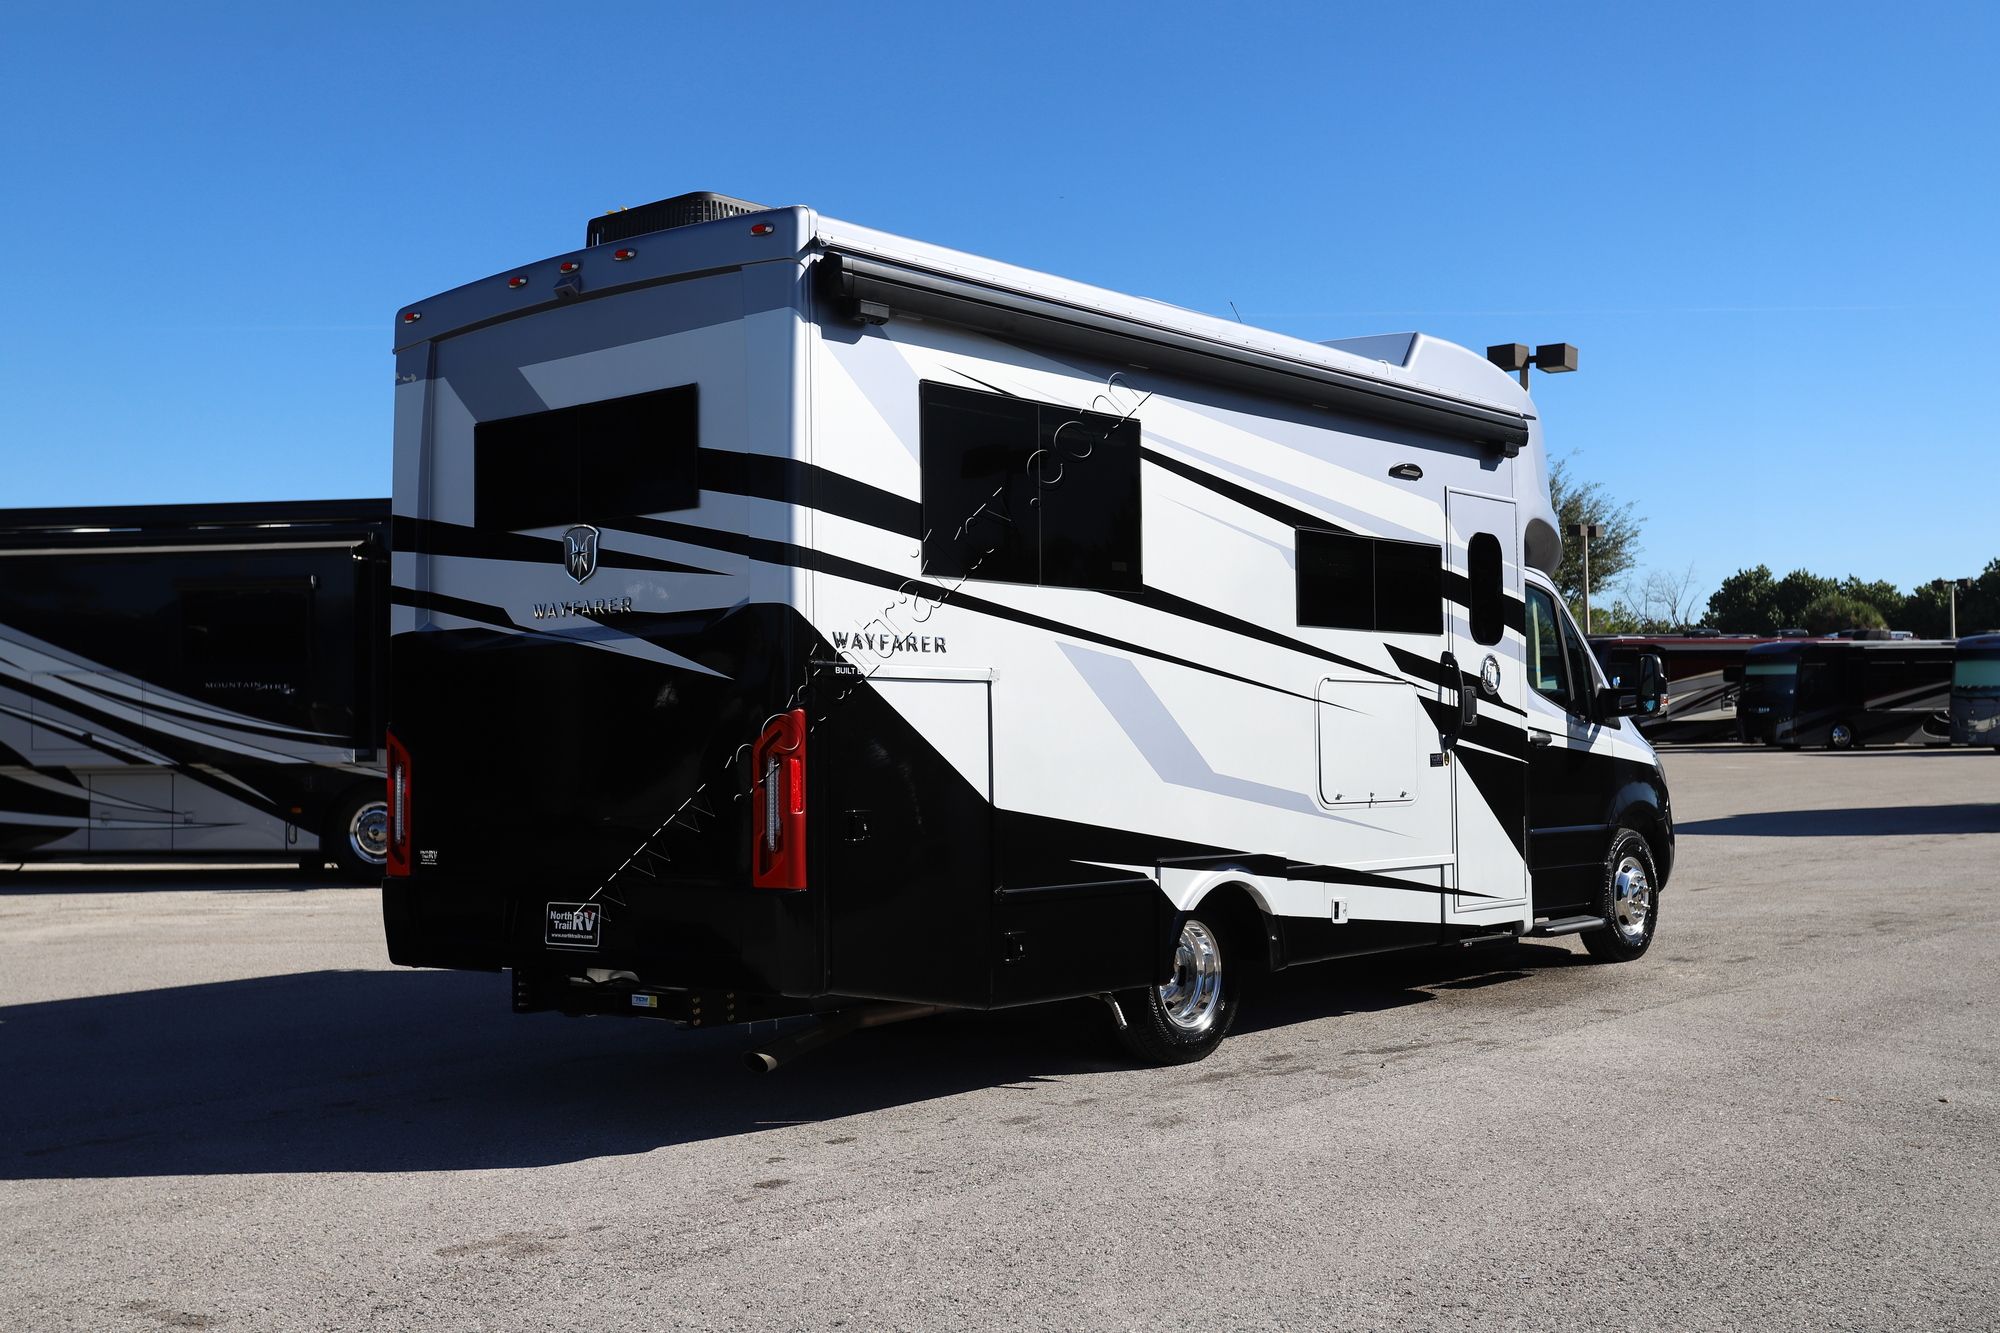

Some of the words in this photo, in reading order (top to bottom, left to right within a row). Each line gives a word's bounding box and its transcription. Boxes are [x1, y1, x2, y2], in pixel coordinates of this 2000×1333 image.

[532, 597, 632, 619] WAYFARER
[832, 631, 947, 653] WAYFARER
[835, 666, 856, 675] BUILT
[205, 681, 260, 689] MOUNTAIN
[550, 911, 573, 920] North
[572, 911, 596, 931] RV
[554, 920, 572, 930] Trail
